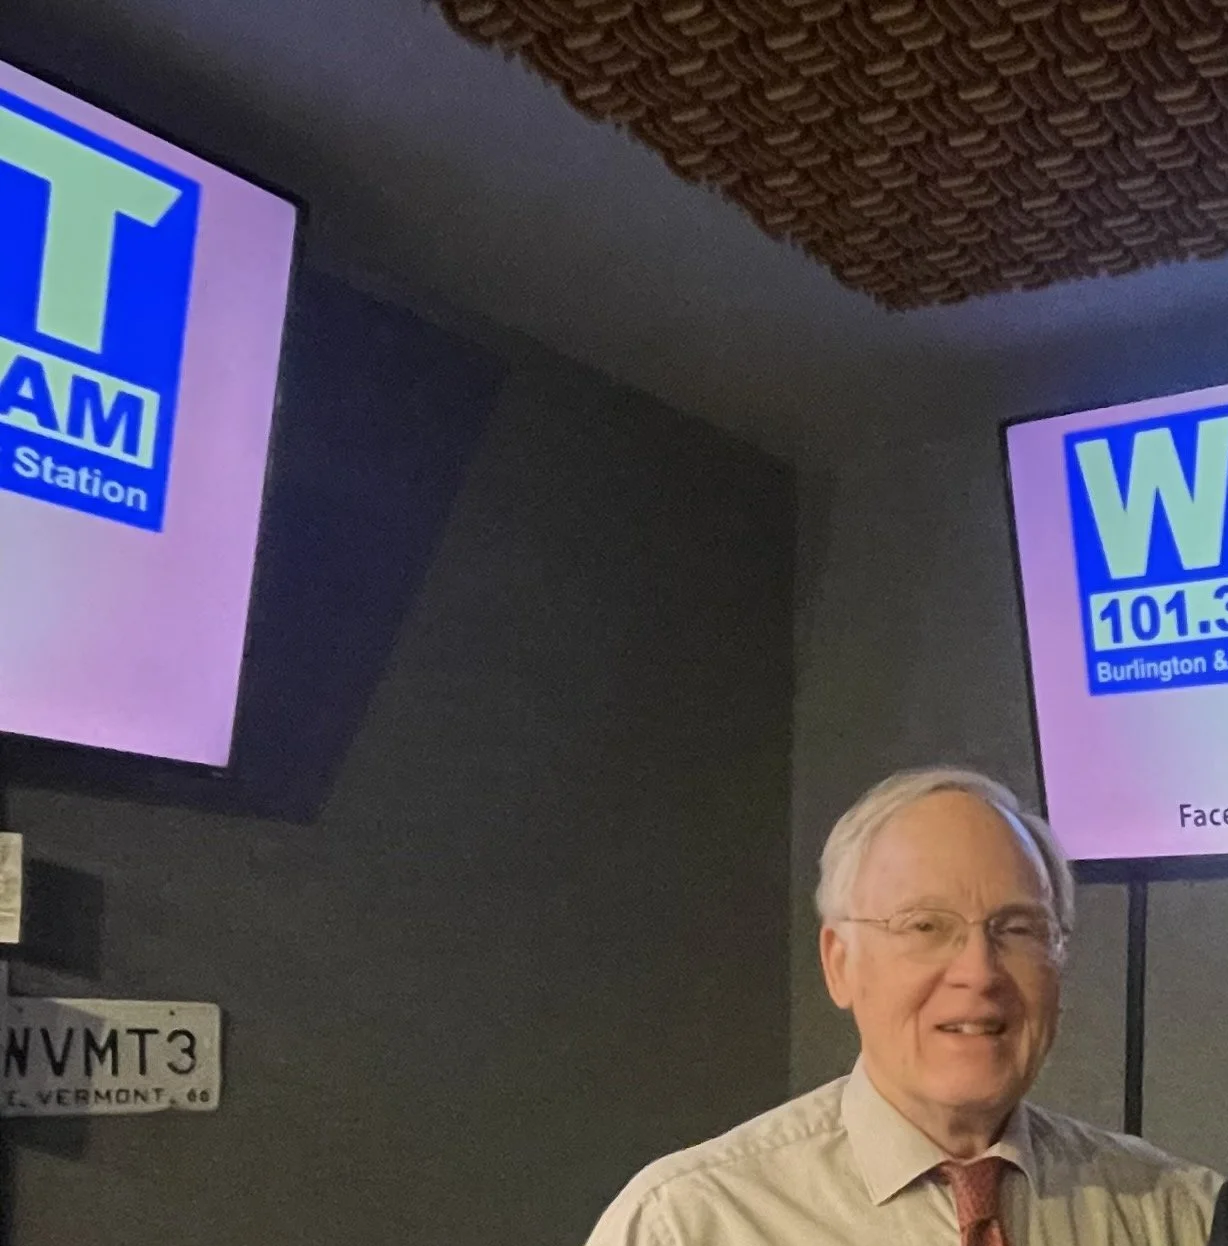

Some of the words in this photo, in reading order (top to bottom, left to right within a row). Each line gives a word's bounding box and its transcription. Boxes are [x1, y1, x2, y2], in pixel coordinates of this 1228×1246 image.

[0, 354, 145, 457] AM
[13, 446, 148, 512] Station
[1096, 654, 1207, 683] Burlington
[1213, 649, 1228, 671] &
[37, 1087, 165, 1105] VERMONT
